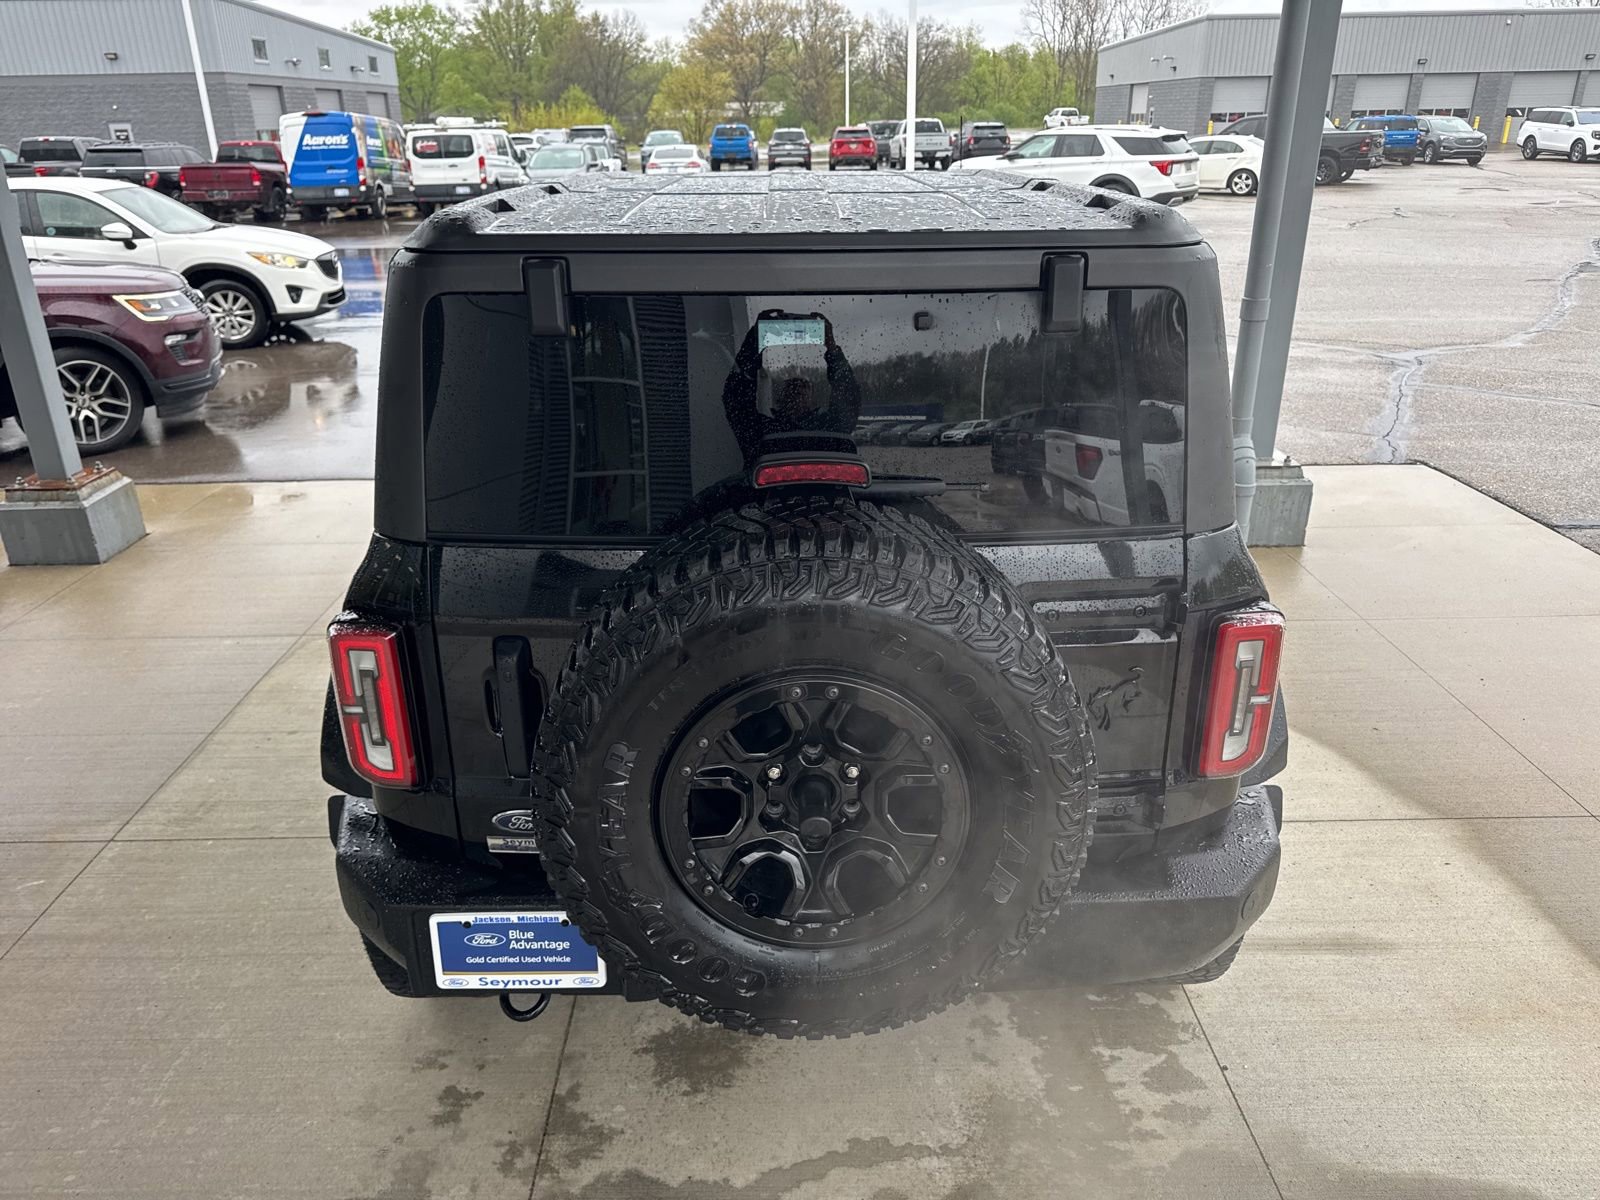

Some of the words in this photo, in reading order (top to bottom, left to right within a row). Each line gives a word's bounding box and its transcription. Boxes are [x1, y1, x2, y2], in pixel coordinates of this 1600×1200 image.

[302, 133, 349, 145] Aaron's
[508, 815, 534, 829] For
[517, 915, 560, 924] Michigan
[508, 930, 534, 940] Blue
[509, 939, 570, 951] Advantage
[487, 955, 520, 963] Certified
[543, 955, 571, 963] Vehicle
[478, 977, 562, 988] Seymour
